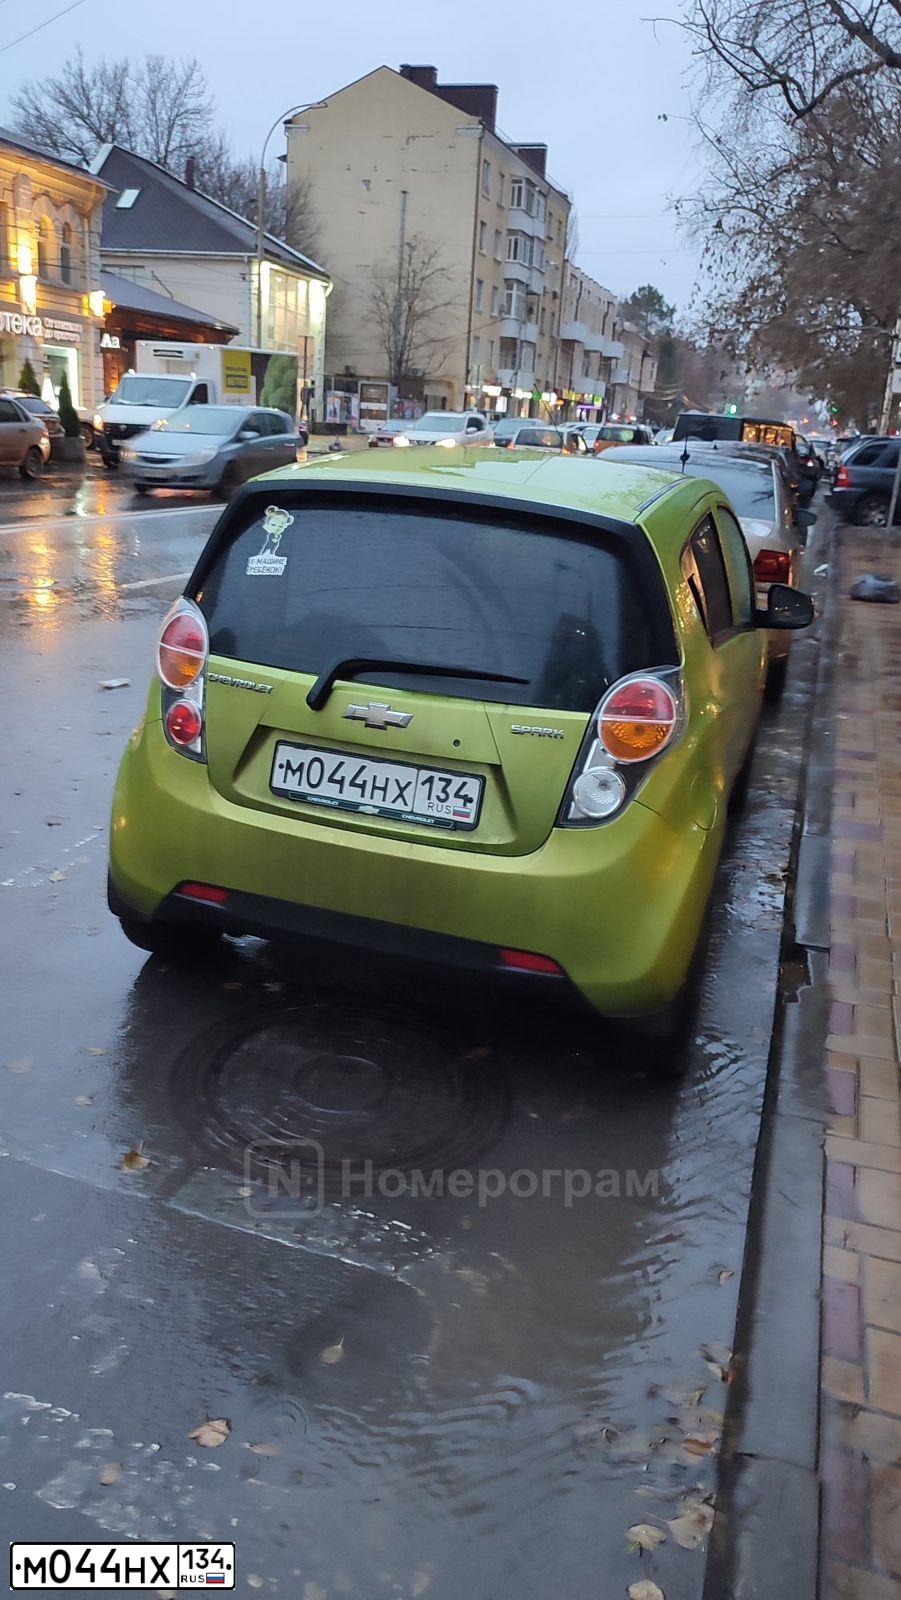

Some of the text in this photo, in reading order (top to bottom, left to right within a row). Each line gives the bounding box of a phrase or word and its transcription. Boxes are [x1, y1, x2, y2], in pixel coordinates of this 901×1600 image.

[206, 672, 274, 694] CHEVROLET
[511, 724, 566, 739] SPARK
[282, 756, 471, 807] М044НХ 134
[306, 796, 339, 806] CHEVROLET
[427, 802, 452, 815] RUS
[401, 814, 435, 825] CHEVROLET
